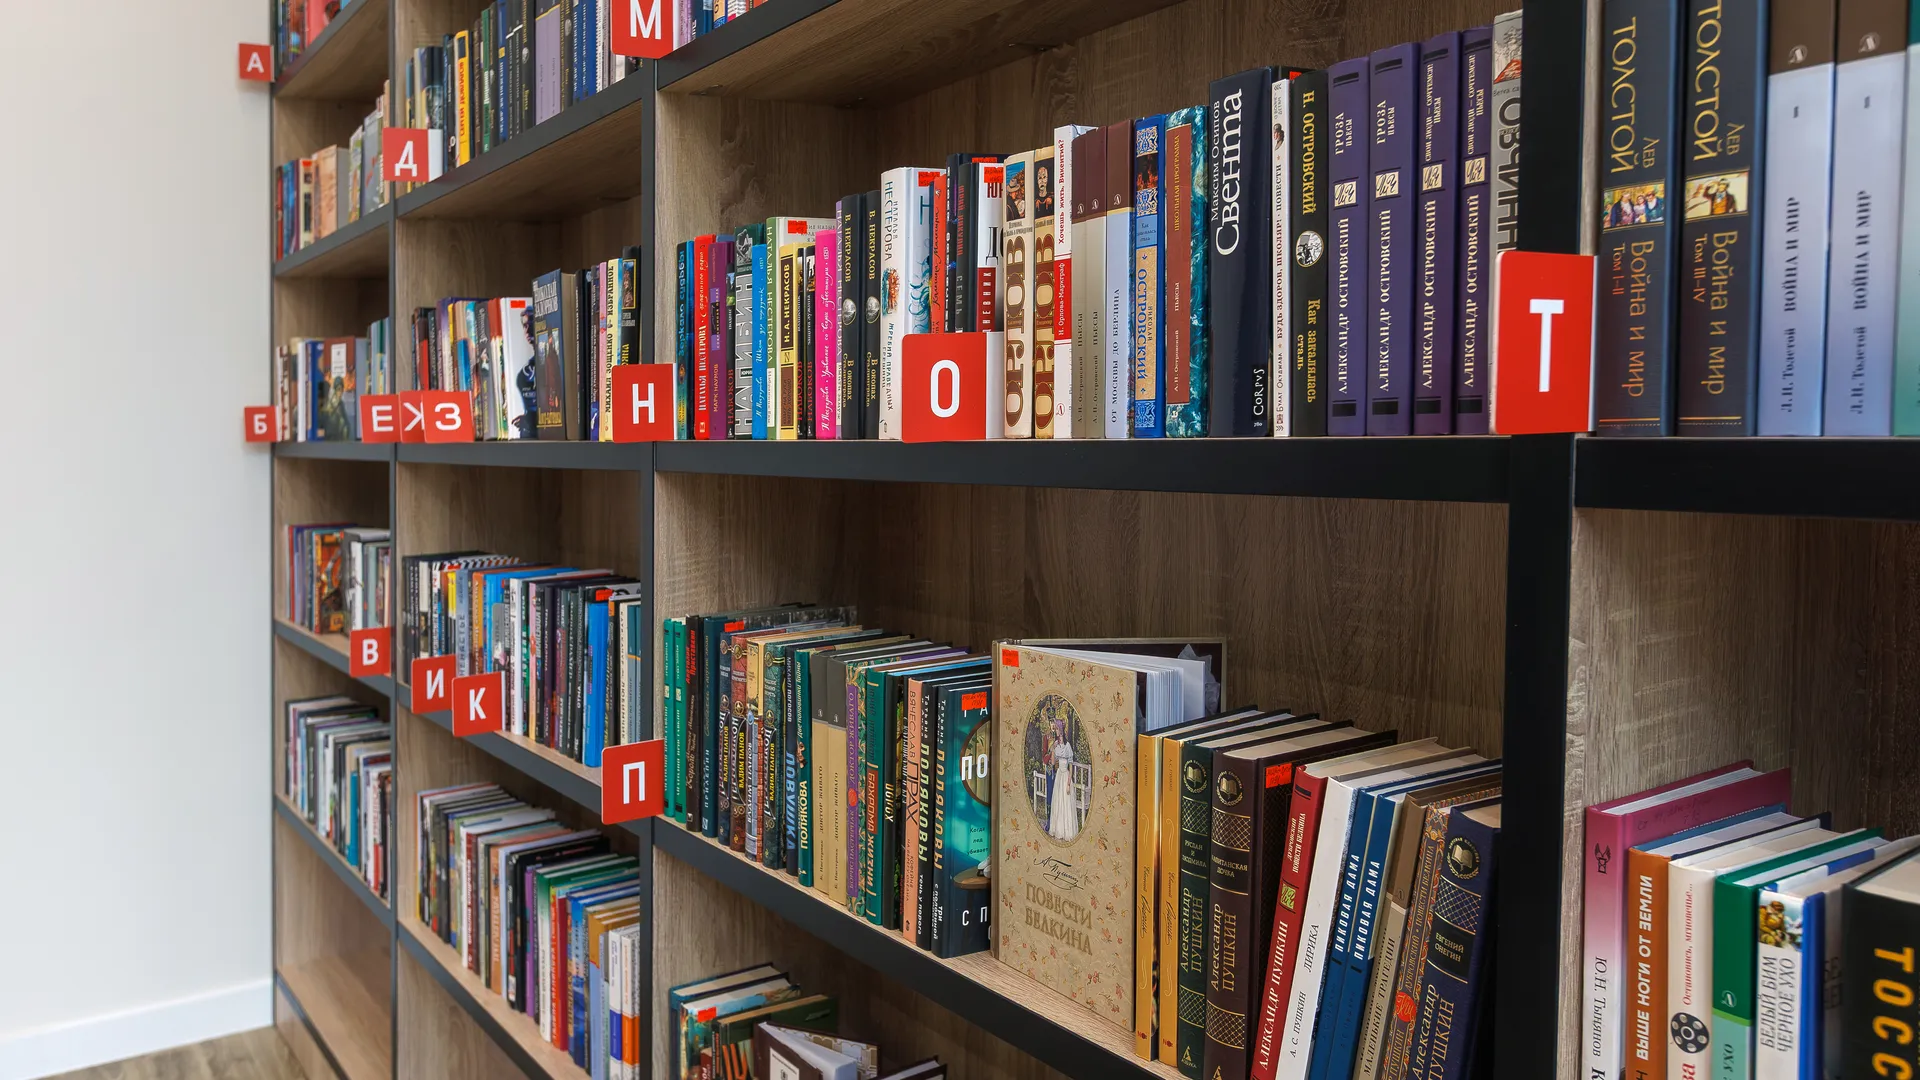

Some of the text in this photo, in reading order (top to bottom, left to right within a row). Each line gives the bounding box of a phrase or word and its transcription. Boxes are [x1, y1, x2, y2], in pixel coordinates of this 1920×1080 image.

[630, 0, 662, 40] М
[246, 53, 264, 74] А
[1692, 0, 1724, 162] ТОЛСТОЙ
[1302, 90, 1314, 108] Н.
[1376, 100, 1386, 144] ГРОЗА
[1468, 109, 1476, 132] ЛЮДИ
[1476, 88, 1484, 116] ПЬЕСЫ
[1610, 16, 1639, 173] ТОЛСТОЙ
[394, 140, 418, 176] Д
[1211, 100, 1220, 221] Максим Осипов
[1335, 112, 1344, 155] ГРОЗА
[1345, 119, 1353, 146] ПЬЕСЫ
[1642, 137, 1660, 168] ЛЕВ
[1726, 122, 1745, 155] ЛЕВ
[1216, 88, 1242, 256] Свента
[844, 214, 852, 282] В. НЕКРАСОВ
[884, 180, 893, 260] НЕСТЕРОВА
[1692, 234, 1708, 264] Том
[678, 250, 686, 300] судьбы
[868, 224, 876, 280] НЕКРАСОВ
[1612, 243, 1625, 271] Том
[1628, 240, 1654, 316] Война
[1710, 230, 1738, 310] Война
[766, 226, 774, 363] НАТАЛЬЯ НЕСТЕРОВА
[1112, 288, 1120, 336] БЕРЛИНА
[1276, 268, 1284, 310] ЗДОРОВ,
[1338, 218, 1350, 394] АЛЕКСАНДР ОСТРОВСКИЙ
[1379, 210, 1391, 392] АЛЕКСАНДР ОСТРОВСКИЙ
[1422, 200, 1436, 389] АЛЕКСАНДР ОСТРОВСКИЙ
[1464, 194, 1478, 388] АЛЕКСАНДР ОСТРОВСКИЙ
[1782, 197, 1800, 379] Толстой ВОЙНА МИР
[1851, 190, 1871, 380] Толстой ВОЙНА МИР
[783, 320, 790, 330] А.
[1006, 235, 1026, 428] ОРЛОВ
[1034, 234, 1054, 430] ОРЛОВ
[1112, 342, 1119, 355] ДО
[1138, 268, 1148, 380] ОСТРОВСКИЙ
[1276, 312, 1284, 338] БУДЬ
[1296, 334, 1304, 370] сталь
[1308, 298, 1320, 403] Как закалялась
[1529, 299, 1564, 392] Т
[735, 273, 752, 435] НАГИБИН
[885, 322, 894, 411] ЖРЕБИЙ ПРАВЕДНЫХ
[372, 405, 394, 432] Е
[434, 402, 462, 430] З
[632, 382, 654, 424] Н
[931, 360, 960, 418] О
[254, 414, 268, 435] Б
[362, 638, 380, 665] В
[426, 670, 444, 698] И
[470, 689, 486, 721] К
[623, 761, 646, 804] П
[738, 732, 746, 788] ВАДИМ ПАНОВ
[786, 752, 796, 850] ЛОВУШКА
[800, 780, 808, 849] ПОЛЯКОВА
[868, 772, 876, 832] БАХРОМА
[908, 760, 918, 826] ПРАХ
[919, 742, 930, 862] ПОЛЯКОВЫ
[934, 749, 944, 869] ПОЛЯКОВЫ
[1286, 818, 1296, 861] ДУБРОВСКИЙ
[1292, 813, 1306, 874] ПОВЕСТИ БЕЛКИНА
[1025, 906, 1092, 956] БЕЛКИНА
[1026, 881, 1092, 930] ПОВЕСТИ
[1180, 888, 1192, 973] Александр
[1334, 854, 1360, 952] ПИКОВАЯ ДАМА
[1354, 860, 1380, 960] ПИКОВАЯ ДАМА
[1404, 845, 1435, 992] ДУБРОВСКИЙ ПОВЕСТИ БЕЛКИНА
[1640, 874, 1653, 932] ЗЕМЛИ
[1192, 896, 1203, 973] ПУШКИН
[1210, 904, 1224, 992] Александр
[1222, 912, 1236, 992] ПУШКИН
[1303, 924, 1320, 972] ЛИРИКА
[1434, 944, 1462, 963] ОНЕГИН
[1435, 932, 1464, 953] ЕВГЕНИЙ
[1638, 934, 1651, 958] ОТ
[1681, 882, 1694, 1006] Остановись, мгновенье...
[1259, 920, 1288, 1070] АЛЕКСАНДР ПУШКИН
[1292, 991, 1307, 1034] ПУШКИН
[1363, 936, 1396, 1076] МАЛЕНЬКИЕ ТРАГЕДИИ
[1638, 962, 1651, 1006] НОГИ
[1758, 956, 1777, 1049] БЕЛЫЙ БИМ
[1776, 958, 1796, 1052] ЧЕРНОЕ УХО
[1412, 984, 1440, 1080] Александр
[1592, 997, 1606, 1057] Тынянов
[1636, 1010, 1650, 1060] ВЫШЕ
[1723, 1044, 1734, 1072] УХО
